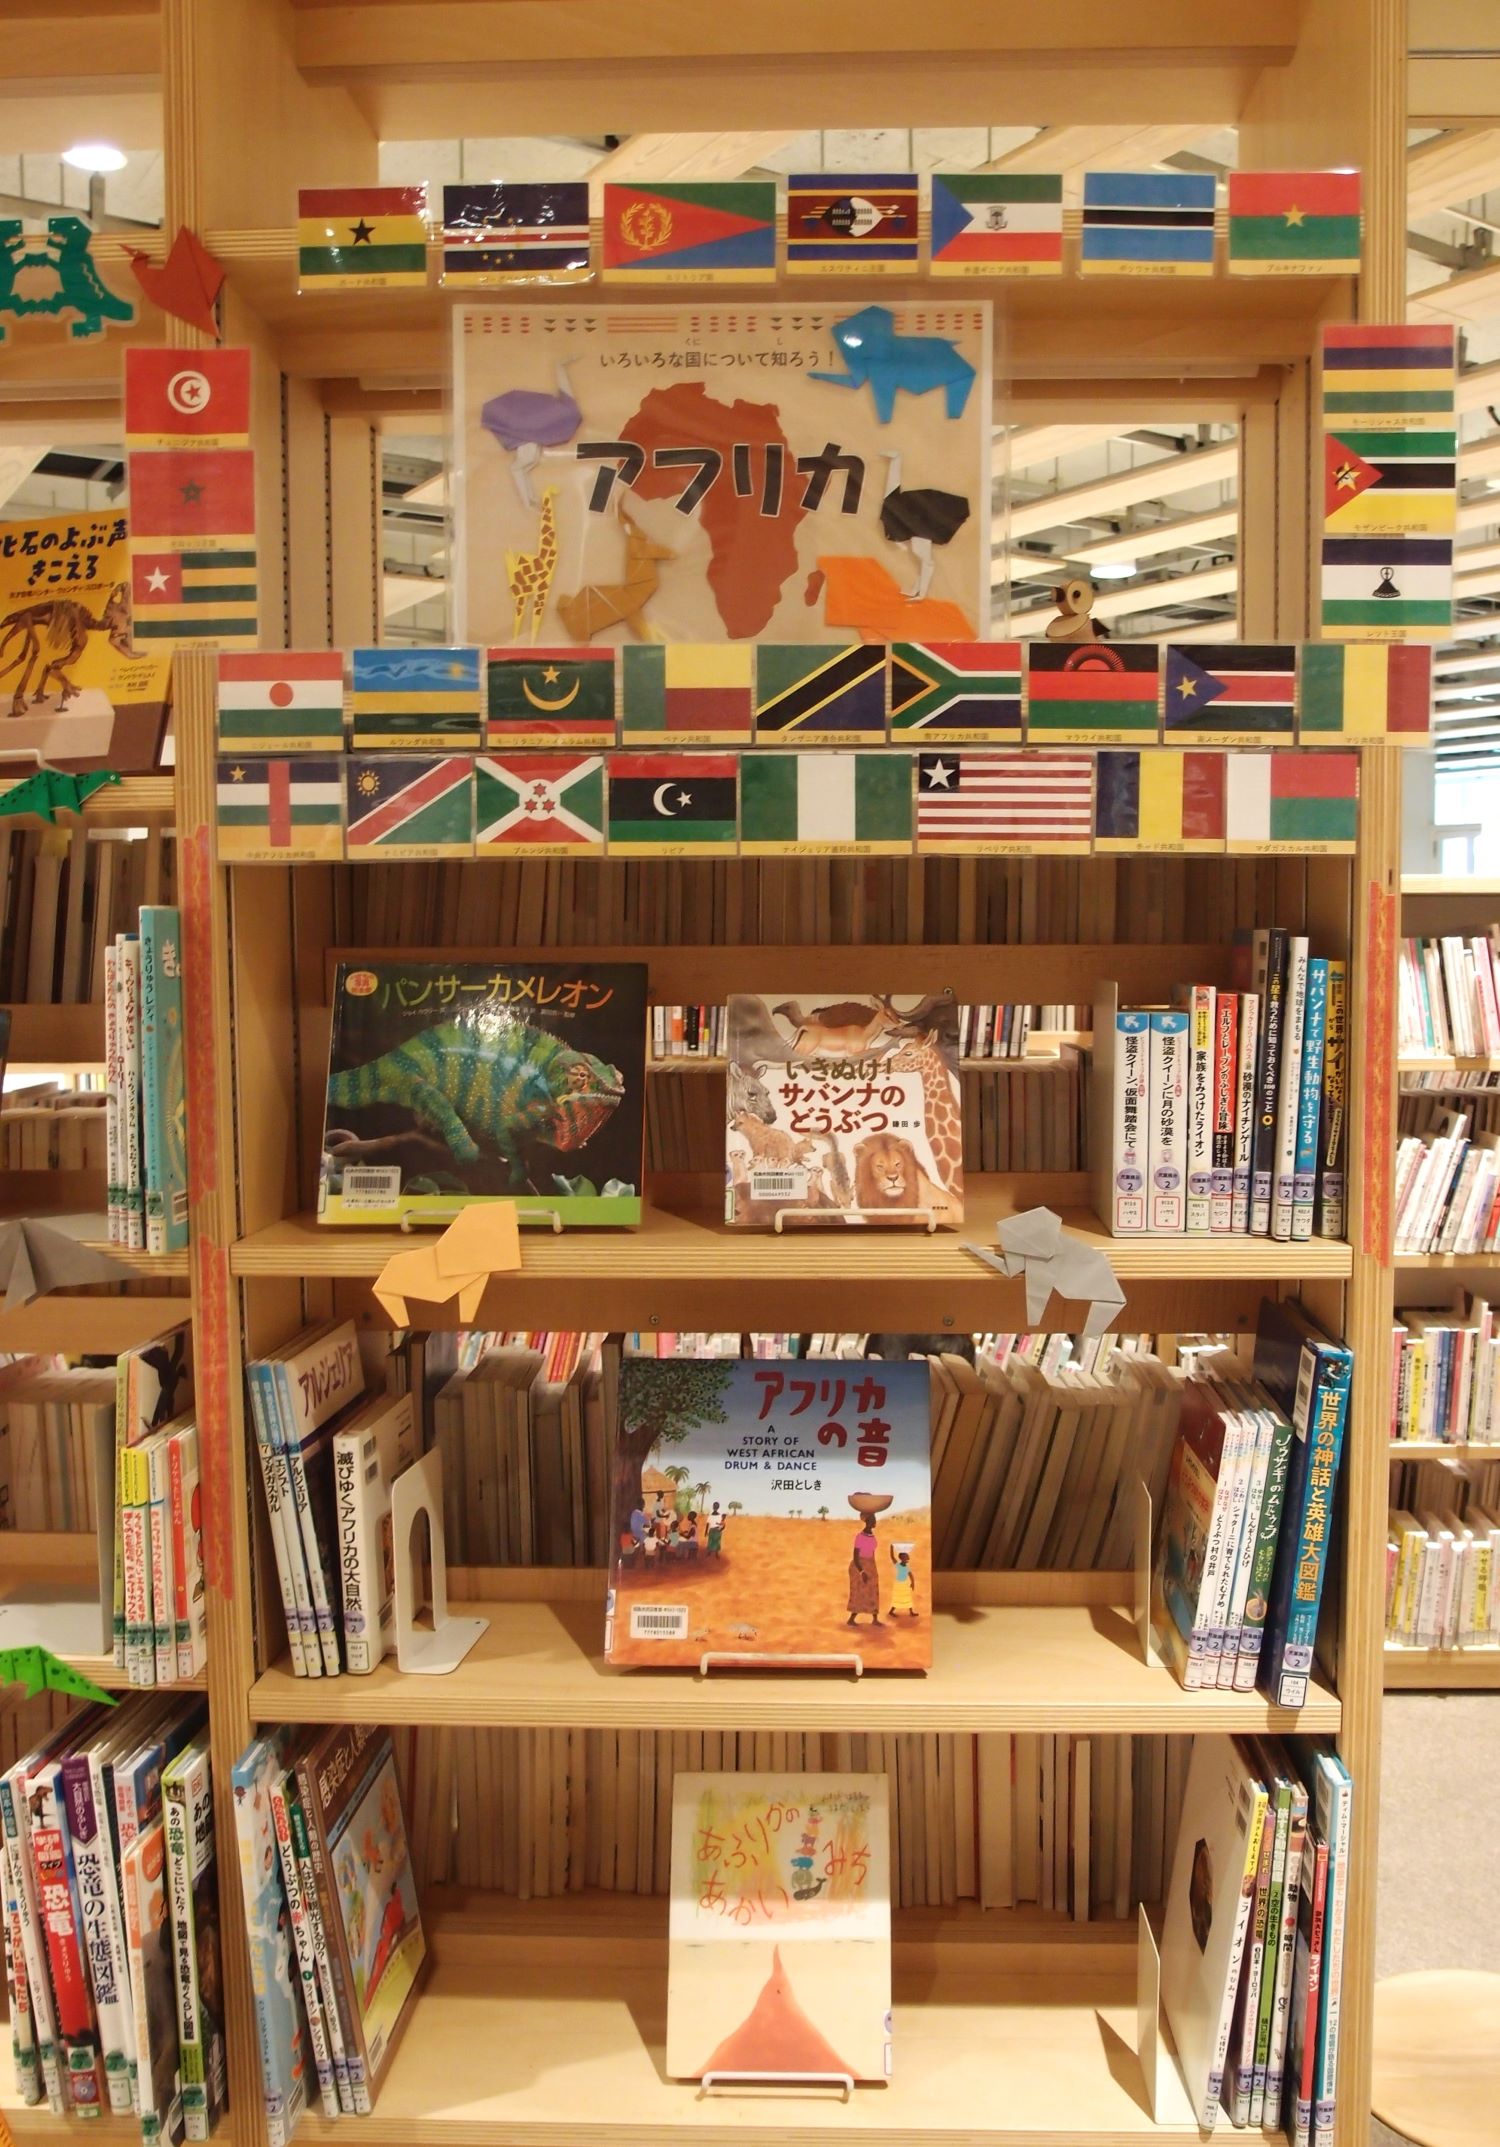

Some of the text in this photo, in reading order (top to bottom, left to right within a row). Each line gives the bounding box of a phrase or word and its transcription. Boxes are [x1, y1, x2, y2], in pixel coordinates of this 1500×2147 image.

[599, 350, 835, 371] いろいろな国について知ろう！
[575, 441, 866, 518] アフリカ
[28, 554, 100, 585] きこえる
[663, 735, 712, 744] ベナン共和国
[924, 732, 990, 741] 南アフリカ共和国
[1064, 733, 1123, 743] マラウイ共和国
[382, 973, 614, 1009] パンサーカメレオン
[1293, 956, 1307, 1042] みんなで地球をまもる
[786, 1057, 892, 1081] いきぬけ！
[1303, 968, 1325, 1145] サバンナで野生動物を守る
[1217, 1009, 1231, 1132] エルフとレーブンのふしぎな冒険
[778, 1082, 906, 1108] サバンナの
[1124, 1035, 1140, 1149] 怪盗クイーン、仮面舞踏会にて
[1160, 1036, 1176, 1147] 怪盗クイーンに月の砂漠を
[1194, 1050, 1208, 1158] 家族をみつけたライオン
[789, 1107, 889, 1134] どうぶつ
[1239, 1071, 1254, 1163] 砂漠のナイチンゲール
[1127, 1183, 1134, 1191] 2
[1165, 1181, 1171, 1189] 2
[1199, 1186, 1205, 1194] 2
[1219, 1184, 1226, 1192] 2
[1260, 1188, 1266, 1196] 2
[1284, 1190, 1291, 1198] 2
[1302, 1190, 1308, 1198] 2
[298, 1340, 354, 1418] アルジェリア
[754, 1370, 888, 1420] アフリカ
[742, 1435, 800, 1447] STORY OF
[767, 1424, 776, 1434] A
[262, 1444, 269, 1454] 7
[726, 1447, 816, 1459] WEST AFRICAN
[817, 1417, 892, 1469] の音
[723, 1460, 818, 1472] DRUM & DANCE
[262, 1456, 282, 1513] マダガスカル
[290, 1456, 305, 1513] アルジェリア
[770, 1479, 822, 1491] 沢田としき
[1295, 1391, 1343, 1603] 世界の神話と英雄大図鑑
[336, 1451, 363, 1612] 滅びゆくアフリカの大自然
[1241, 1513, 1257, 1568] しんぞうとひげ
[1206, 1513, 1225, 1577] どうぶつ村の井戸
[1197, 1644, 1203, 1652] 2
[1230, 1643, 1237, 1651] 2
[1249, 1641, 1255, 1650] 2
[1294, 1659, 1300, 1667] 2
[822, 1839, 872, 1886] みち
[282, 1844, 311, 1964] どうぶつの赤ちゃん
[699, 1870, 789, 1927] あかい
[1287, 1883, 1298, 1902] 動物
[44, 1883, 74, 1937] 恐竜
[77, 1853, 120, 2005] 恐竜の生態図鑑
[169, 1808, 195, 2040] あの恐竜どこにいた？ 地図で見る恐竜のくらし図鑑
[1267, 1899, 1281, 1947] 空の生きもの
[1227, 1902, 1250, 1999] ライオンのひみつ
[1283, 1933, 1294, 1953] 時間
[1309, 1954, 1321, 1993] ライオン
[1213, 2085, 1219, 2094] 2
[1244, 2081, 1250, 2089] 2
[1255, 2078, 1261, 2087] 2
[1274, 2084, 1280, 2093] 2
[1302, 2114, 1308, 2123] 2
[1325, 2114, 1331, 2123] 2
